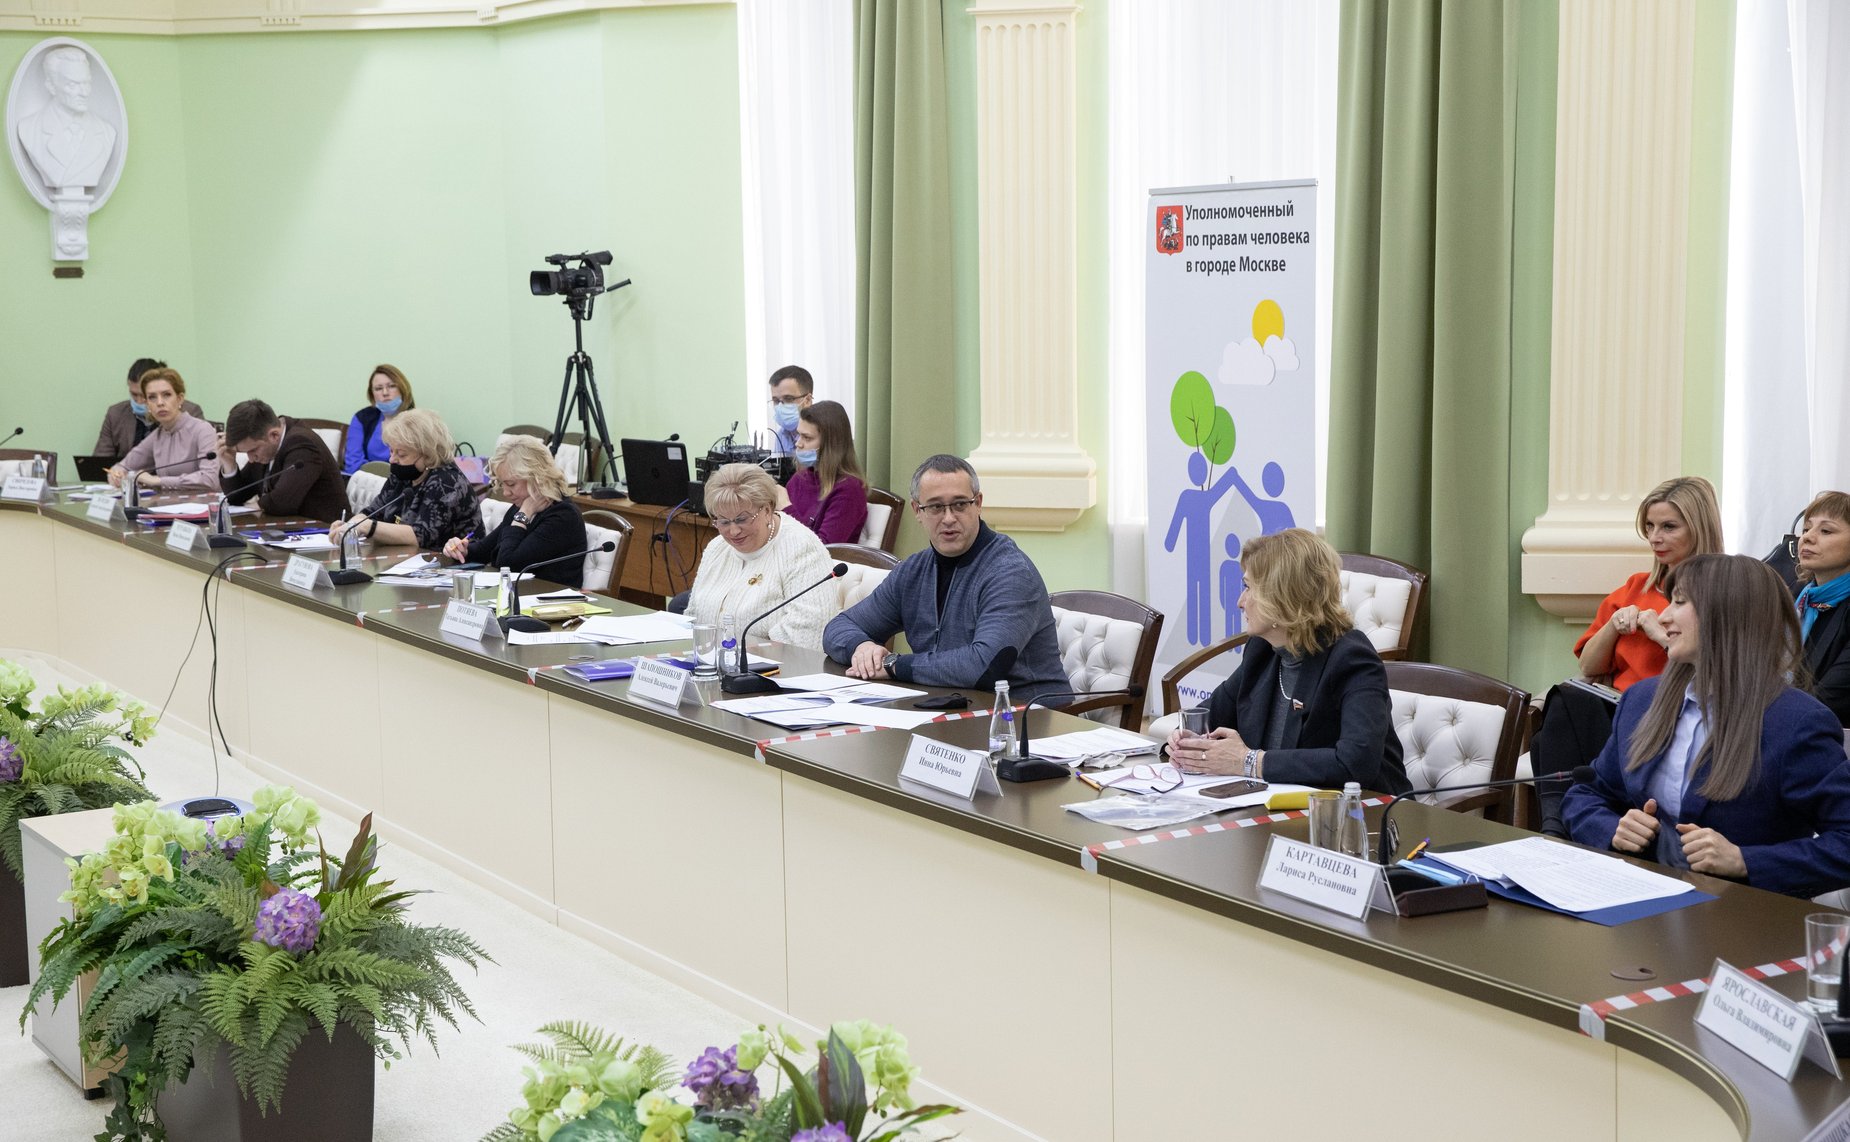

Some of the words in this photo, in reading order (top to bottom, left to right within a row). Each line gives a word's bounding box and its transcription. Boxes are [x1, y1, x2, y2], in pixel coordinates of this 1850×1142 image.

[1185, 200, 1294, 220] Уполномоченный
[1186, 234, 1199, 246] по
[1202, 233, 1247, 250] правам
[1251, 230, 1310, 245] человека
[1186, 261, 1192, 272] в
[1195, 259, 1236, 276] городе
[1239, 255, 1286, 272] Москве
[925, 743, 966, 764] СВЯТЕНКО
[935, 761, 962, 778] Юрьевна
[1286, 846, 1357, 879] КАРТАВЦЕВА
[1276, 862, 1306, 879] Лариса
[1308, 871, 1357, 896] Руслановна
[1722, 976, 1797, 1032] ЯРОСЛАВСКАЯ
[1713, 994, 1736, 1017] Ольга
[1736, 1011, 1792, 1053] Владимировна
